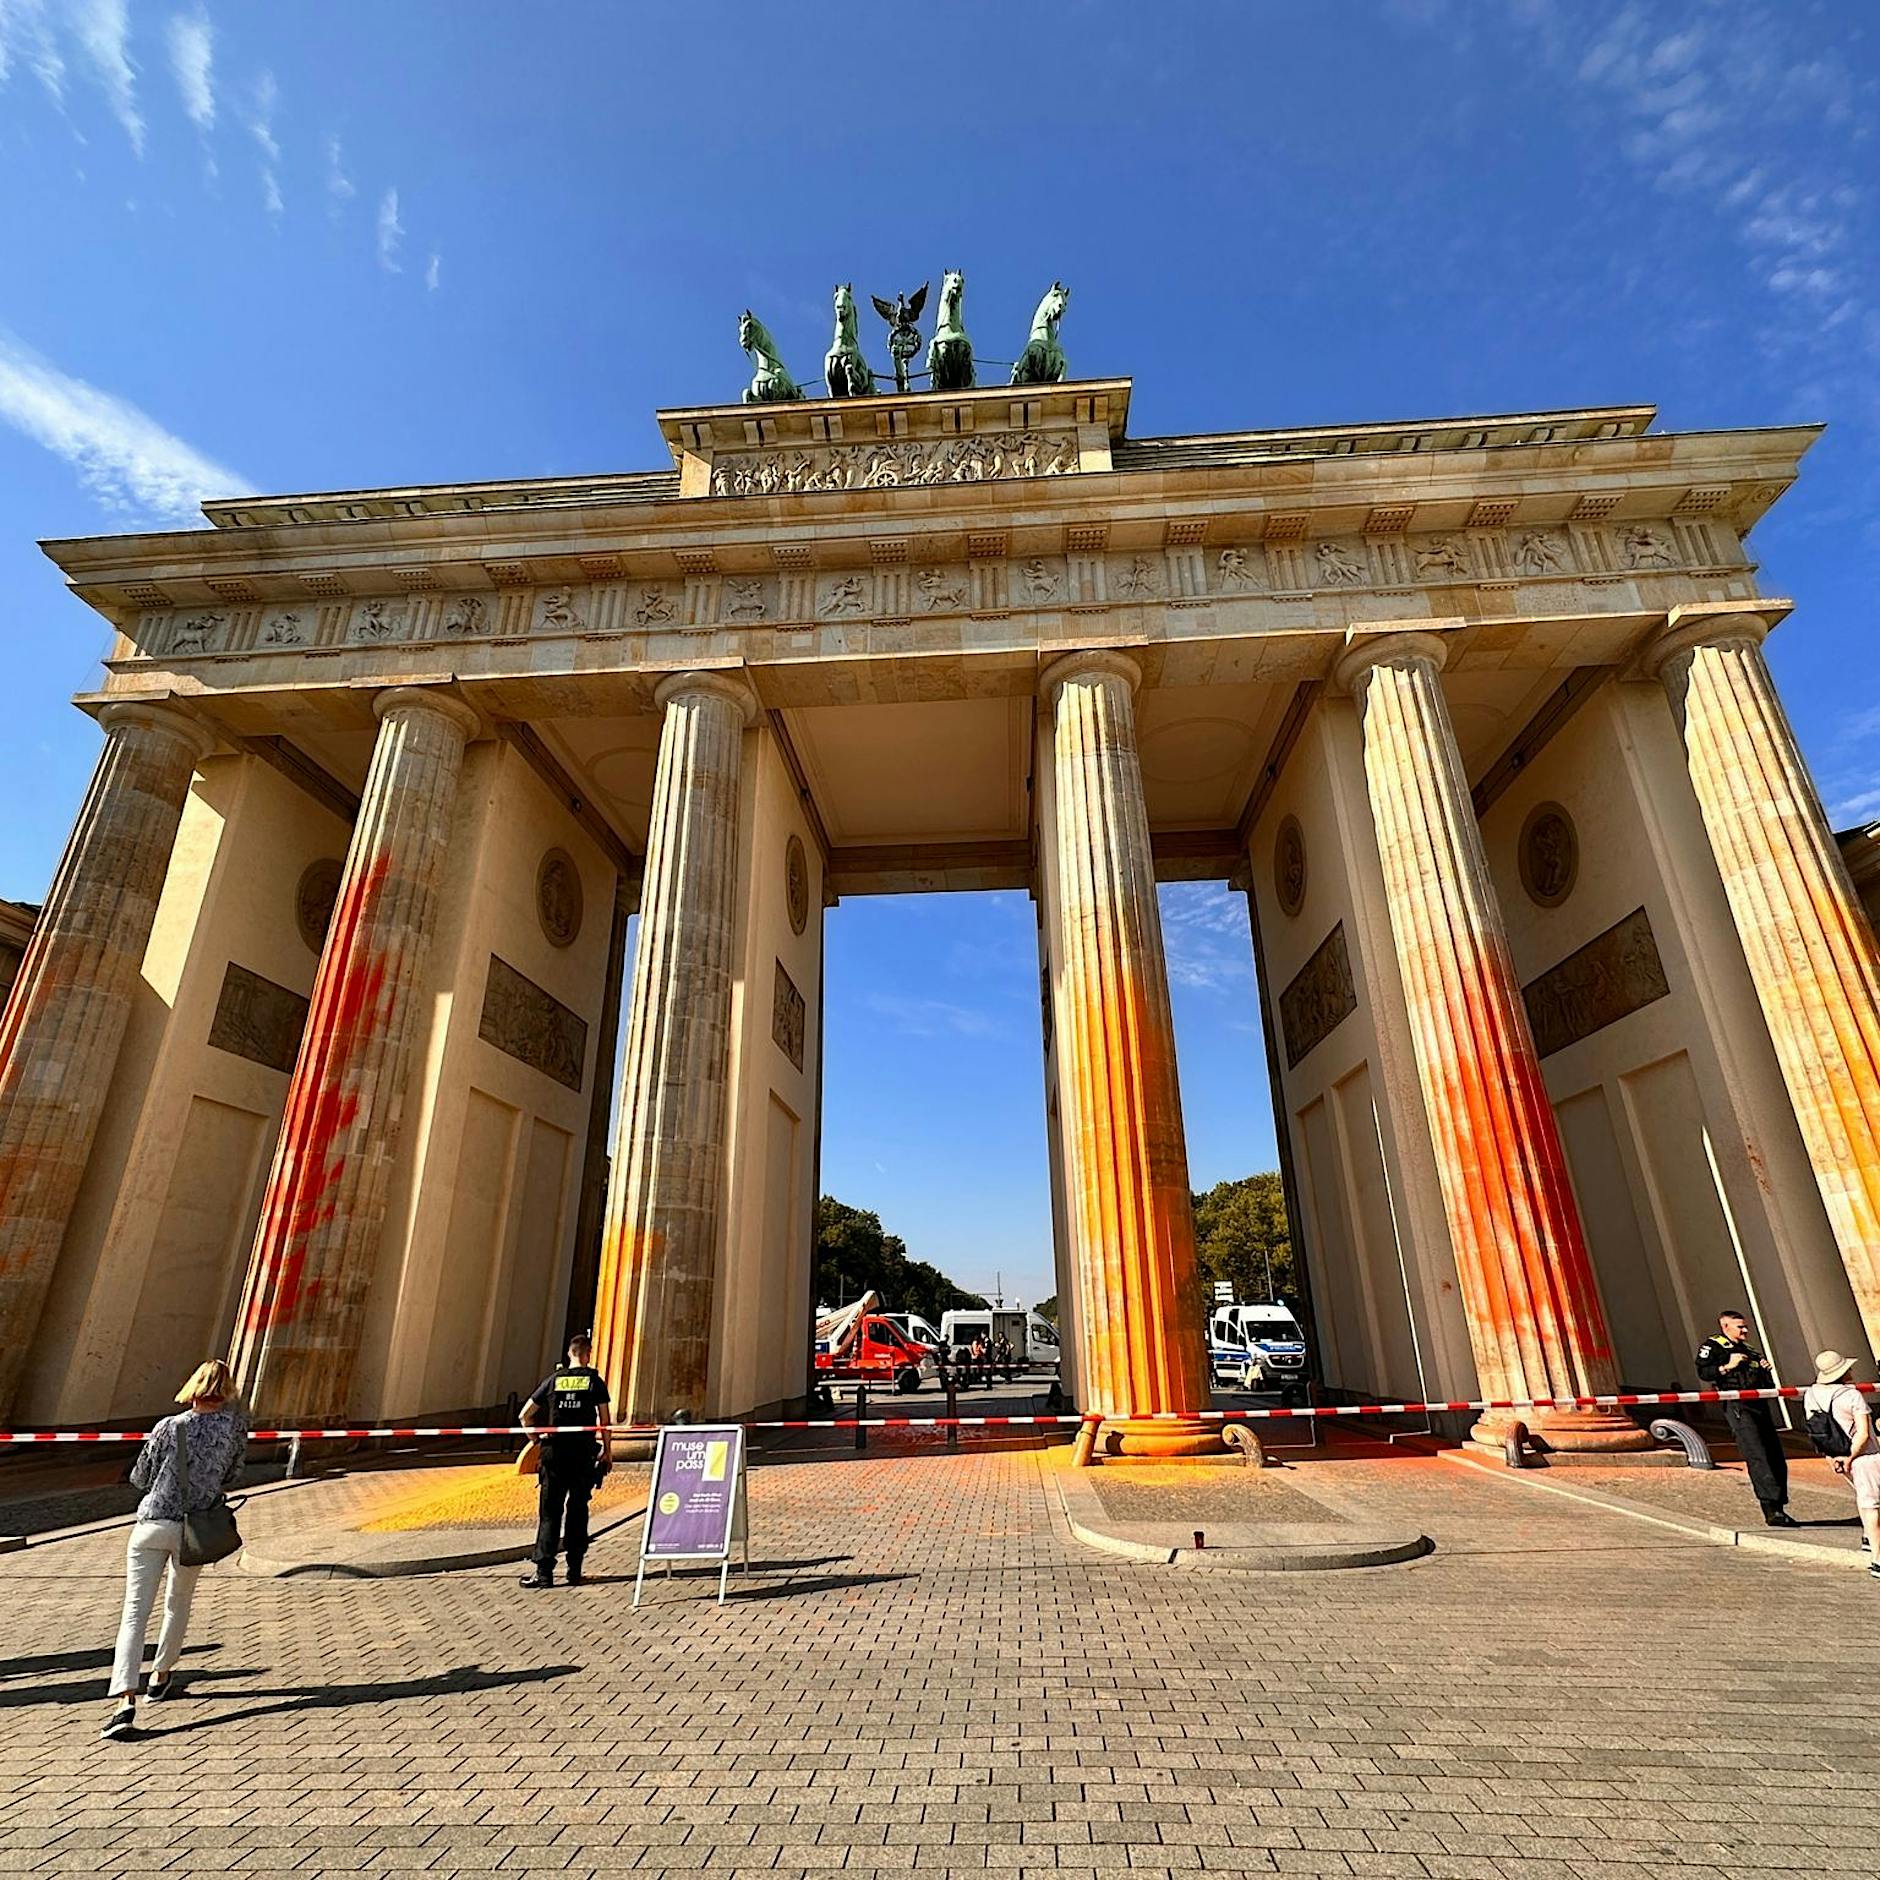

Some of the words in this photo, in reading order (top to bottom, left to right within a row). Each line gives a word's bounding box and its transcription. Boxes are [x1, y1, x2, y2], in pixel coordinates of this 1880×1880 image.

[671, 1441, 705, 1451] muse
[686, 1451, 706, 1460] um
[675, 1459, 704, 1473] pass
